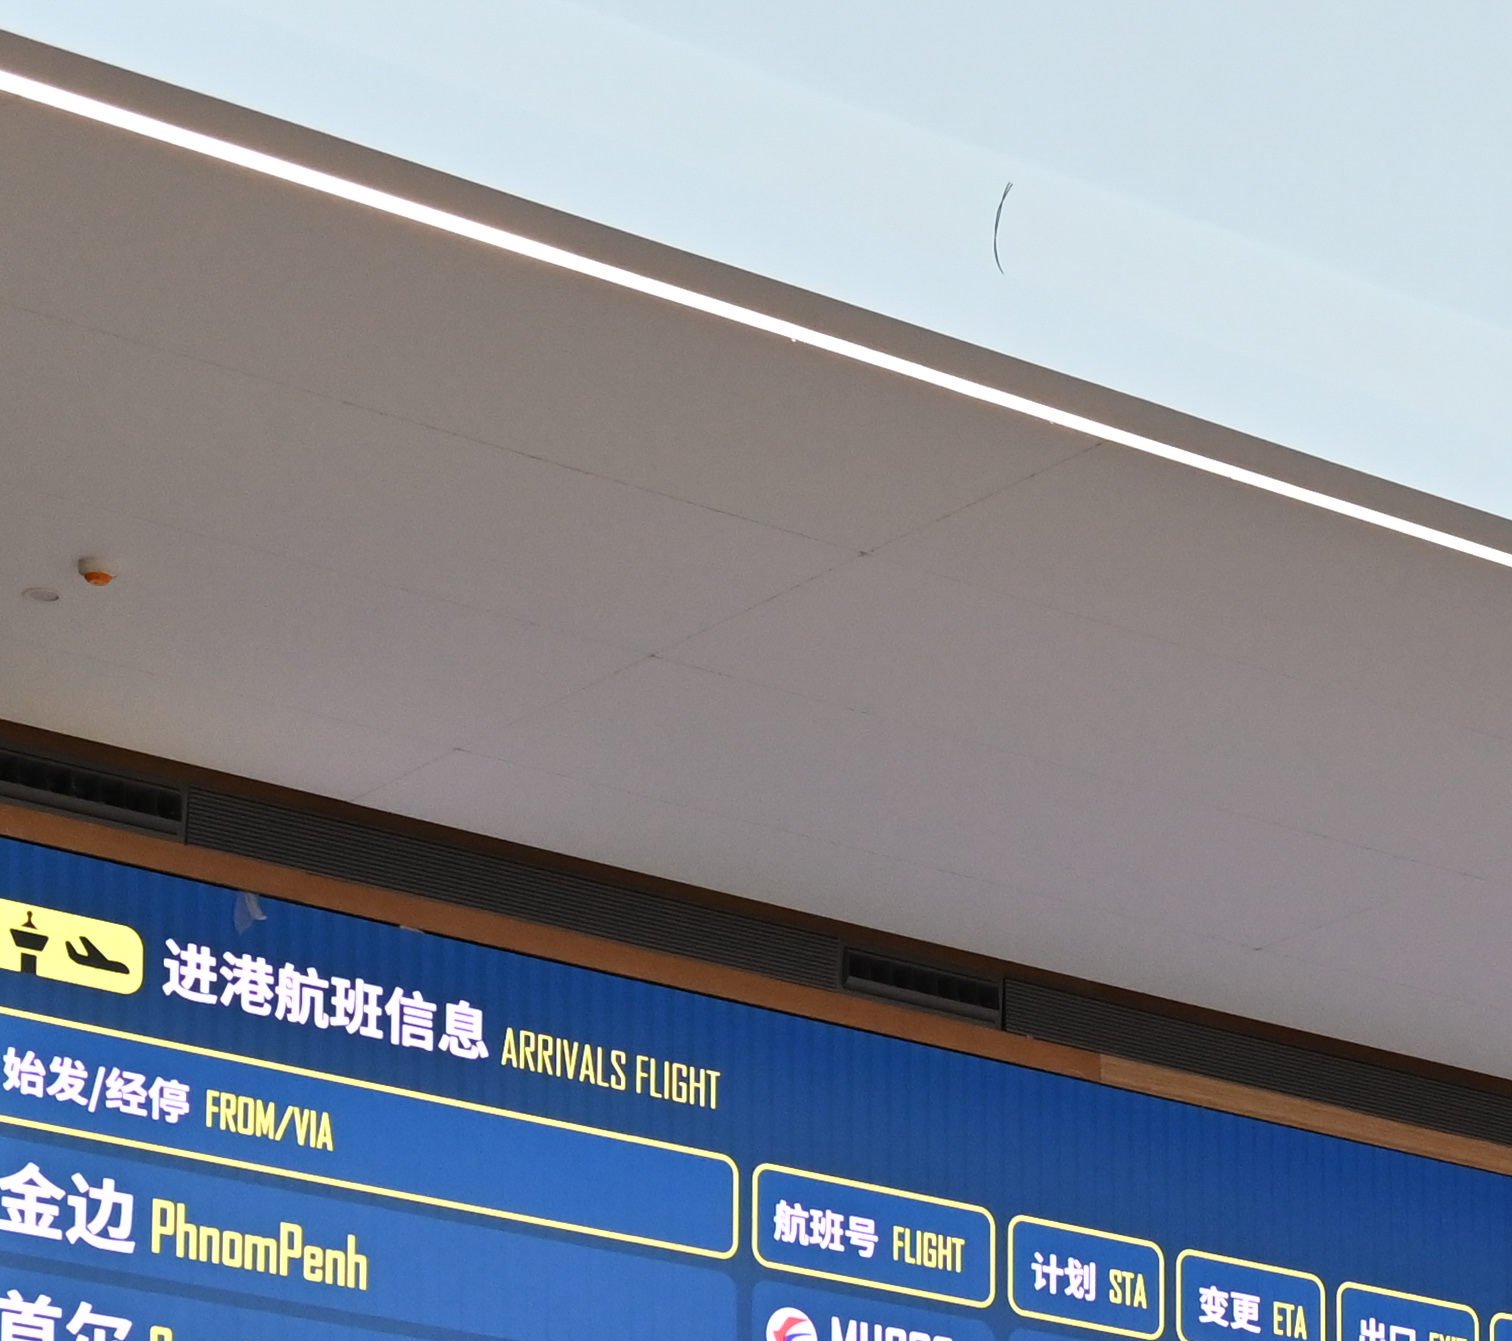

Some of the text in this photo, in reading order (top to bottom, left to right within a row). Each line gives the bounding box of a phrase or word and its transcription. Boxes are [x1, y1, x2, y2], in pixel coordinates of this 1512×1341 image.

[162, 938, 721, 1110] 进港航班信息 ARRIVALS FLIGHT
[205, 1089, 334, 1152] FROM/VIA
[151, 1197, 368, 1291] PhnomPenh
[773, 1199, 966, 1273] 航班号 FLIGHT
[1031, 1251, 1148, 1310] 计划 STA
[1198, 1285, 1308, 1341] 变更 ETA
